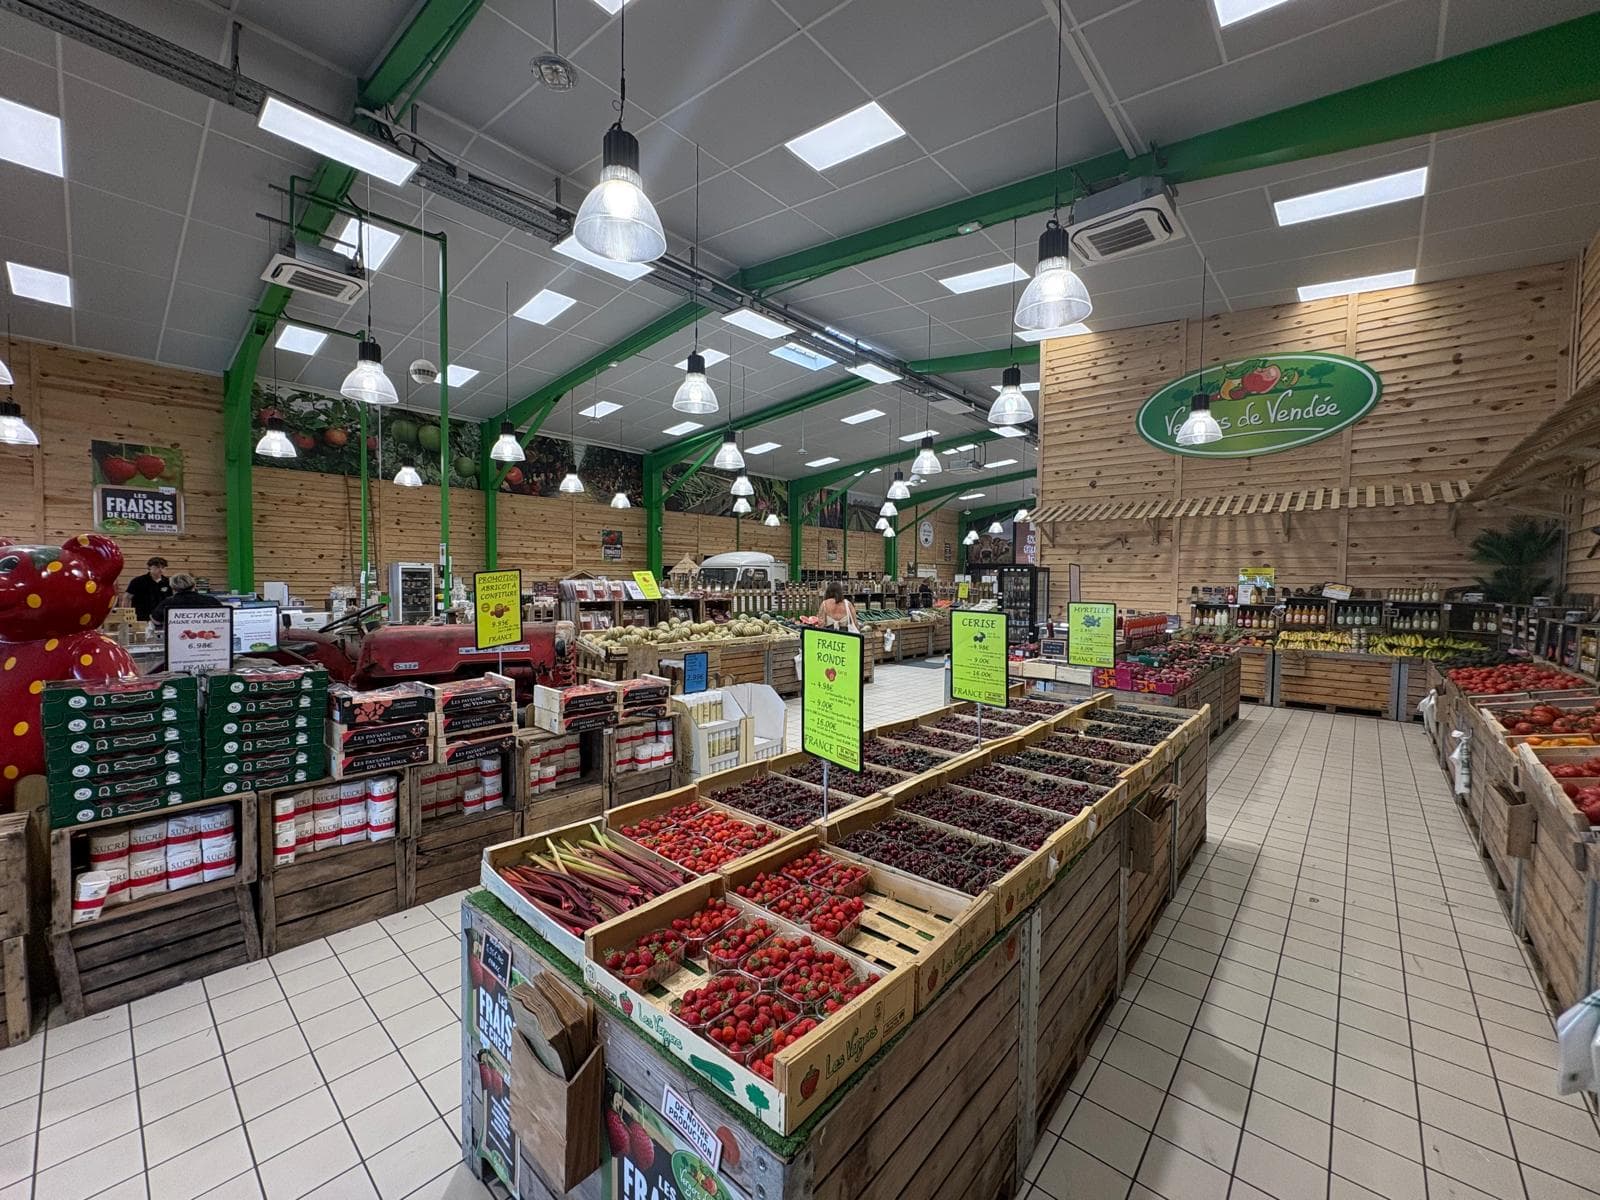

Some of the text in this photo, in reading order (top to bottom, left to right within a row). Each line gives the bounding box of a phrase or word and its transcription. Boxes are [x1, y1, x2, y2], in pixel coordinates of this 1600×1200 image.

[1238, 402, 1263, 427] de
[1267, 389, 1340, 424] Vendée
[106, 497, 173, 514] FRAISES
[122, 512, 146, 520] CHEZ
[480, 583, 511, 592] ABRICOT
[962, 618, 997, 629] CERISE
[488, 633, 513, 643] FRANCE
[817, 638, 847, 653] FRAISE
[817, 652, 847, 667] RONDE
[954, 687, 983, 699] FRANCE
[805, 734, 835, 754] FRANCE
[317, 793, 338, 801] SUCRE
[343, 789, 364, 797] SUCRE
[203, 820, 229, 831] SUCRE
[319, 823, 340, 832] SUCRE
[344, 819, 365, 827] SUCRE
[171, 825, 199, 836] SUCRE
[133, 833, 164, 843] SUCRE
[94, 841, 127, 853] SUCRE
[206, 851, 233, 862] SUCRE
[171, 857, 200, 870] SUCRE
[134, 866, 164, 878] SUCRE
[498, 993, 508, 1010] LES
[480, 985, 513, 1048] FRAIS
[638, 1002, 653, 1029] Les
[480, 1015, 489, 1034] DE
[489, 1029, 506, 1057] CHEZ
[825, 1053, 845, 1080] Les
[675, 1101, 710, 1143] DE NOTRE
[669, 1107, 713, 1159] PRODUCTION
[659, 1174, 677, 1200] LES
